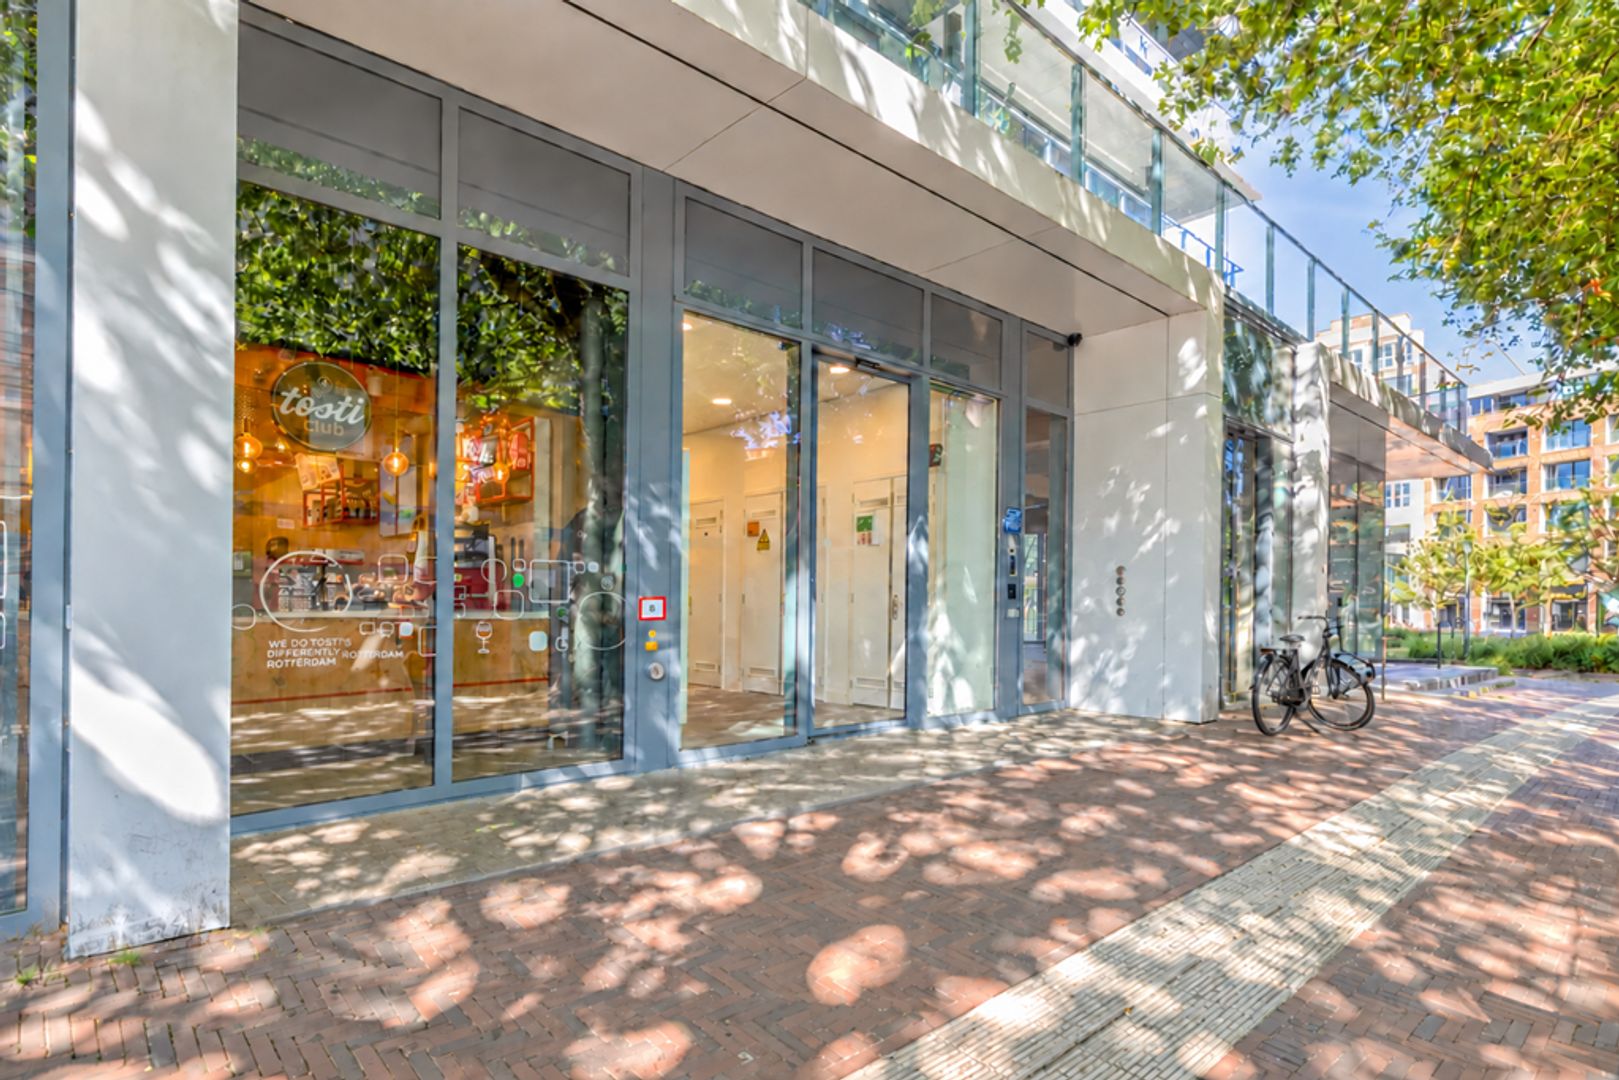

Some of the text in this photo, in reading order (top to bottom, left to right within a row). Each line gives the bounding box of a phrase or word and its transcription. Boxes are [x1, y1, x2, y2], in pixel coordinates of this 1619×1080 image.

[280, 387, 365, 424] tosti
[268, 639, 287, 649] WE
[291, 638, 308, 648] DO
[267, 648, 340, 658] DIFFERENTLY
[267, 657, 337, 669] ROTTERDAM
